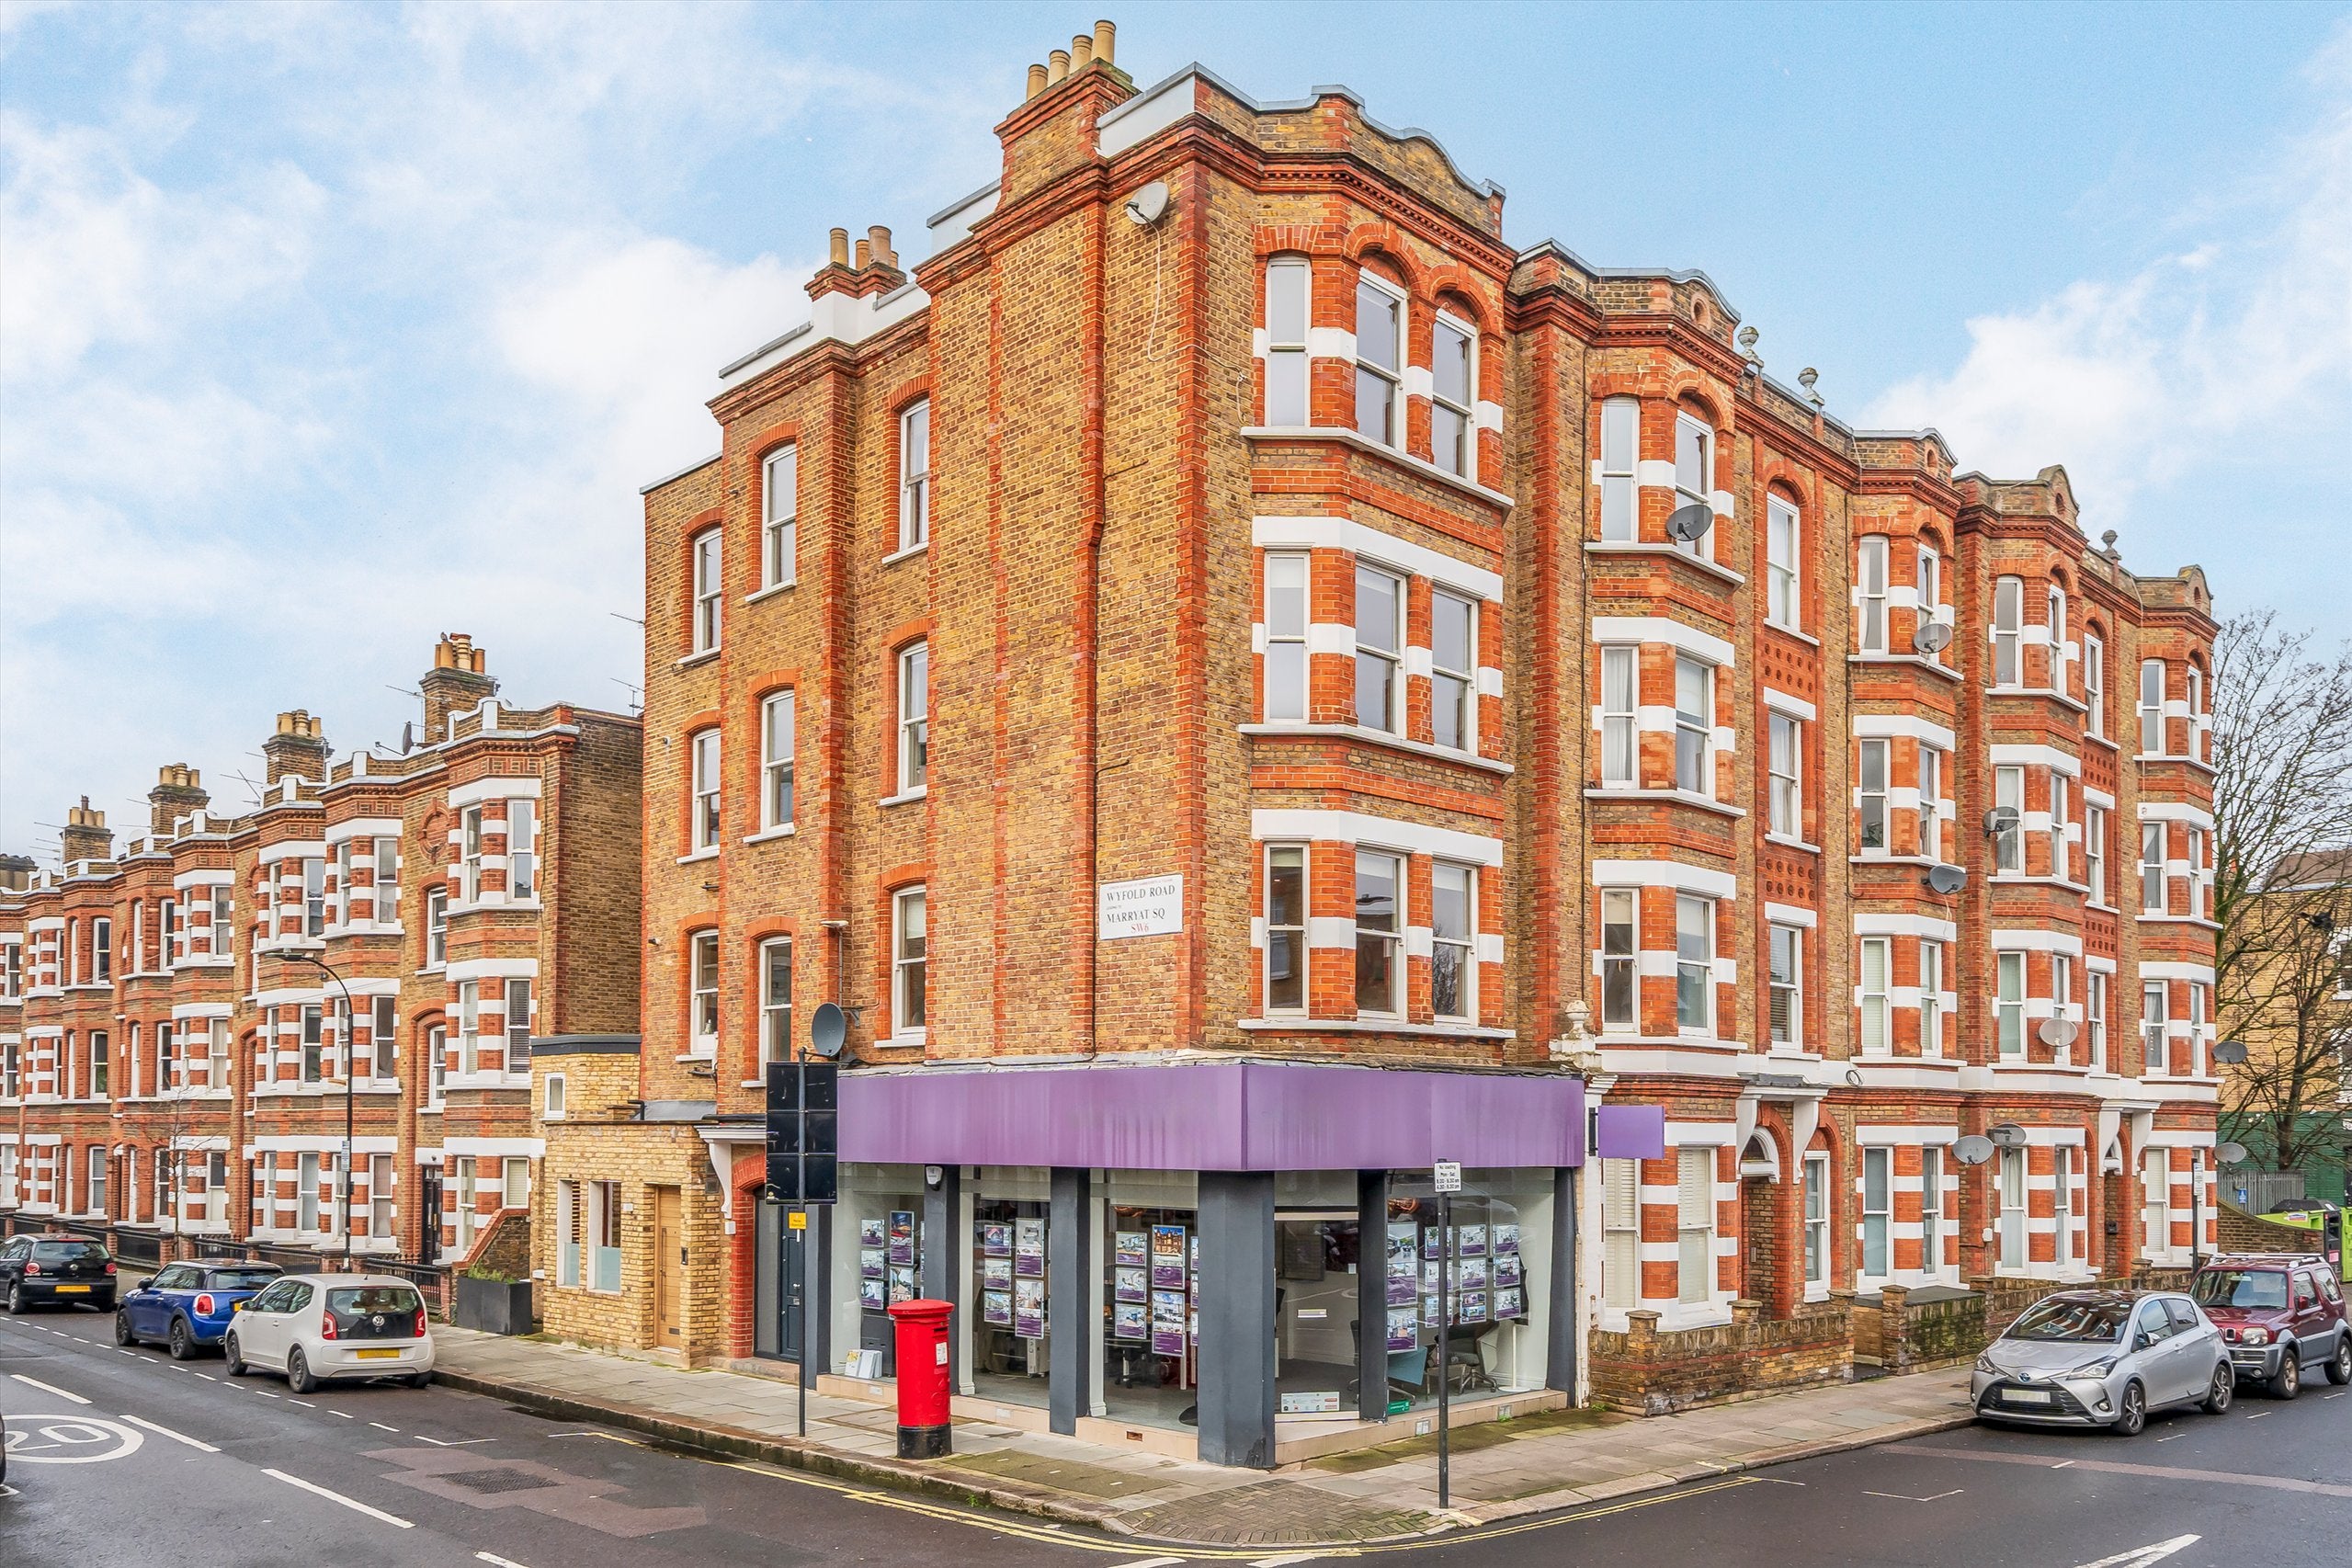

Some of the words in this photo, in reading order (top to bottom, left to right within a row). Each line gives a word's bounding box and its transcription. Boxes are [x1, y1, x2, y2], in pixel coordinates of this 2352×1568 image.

[1107, 889, 1146, 902] WYFOLD
[1149, 884, 1176, 898] ROAD
[1107, 909, 1149, 923] MARRYAT
[1153, 907, 1165, 919] SQ
[1131, 923, 1149, 934] SW6
[5, 1424, 111, 1452] 20
